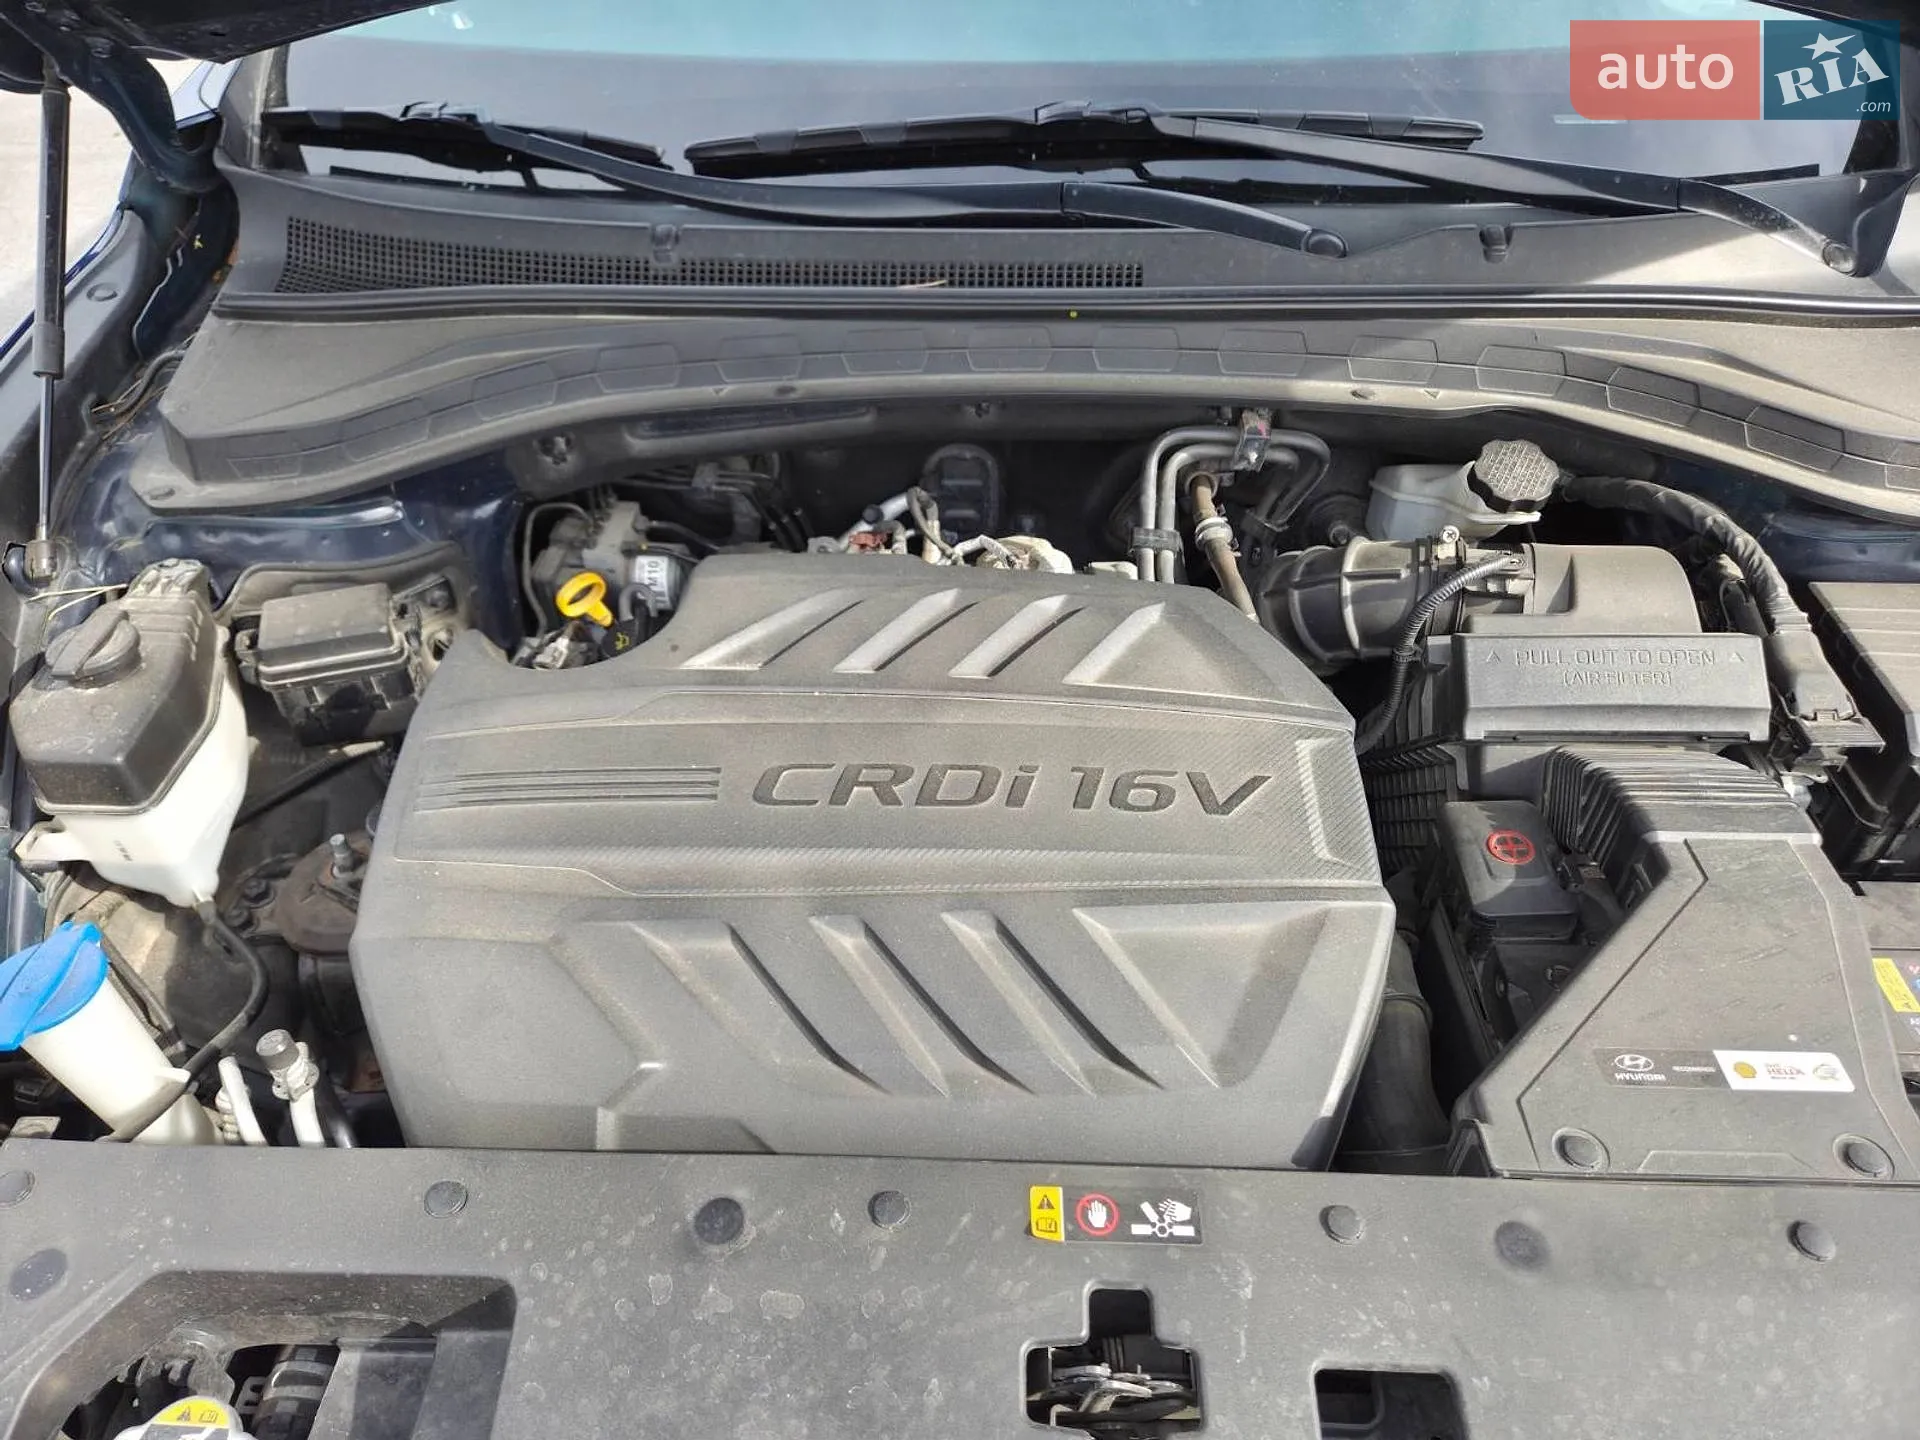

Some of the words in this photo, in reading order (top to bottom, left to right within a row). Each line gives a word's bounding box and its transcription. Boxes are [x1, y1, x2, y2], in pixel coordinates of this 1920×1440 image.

[1515, 648, 1569, 666] PULL
[1575, 648, 1619, 666] OUT
[1624, 649, 1652, 666] TO
[1659, 649, 1716, 667] OPEN
[751, 762, 1044, 810] CRDi
[1070, 765, 1273, 816] 16V
[1614, 1072, 1667, 1082] HYUNDAI
